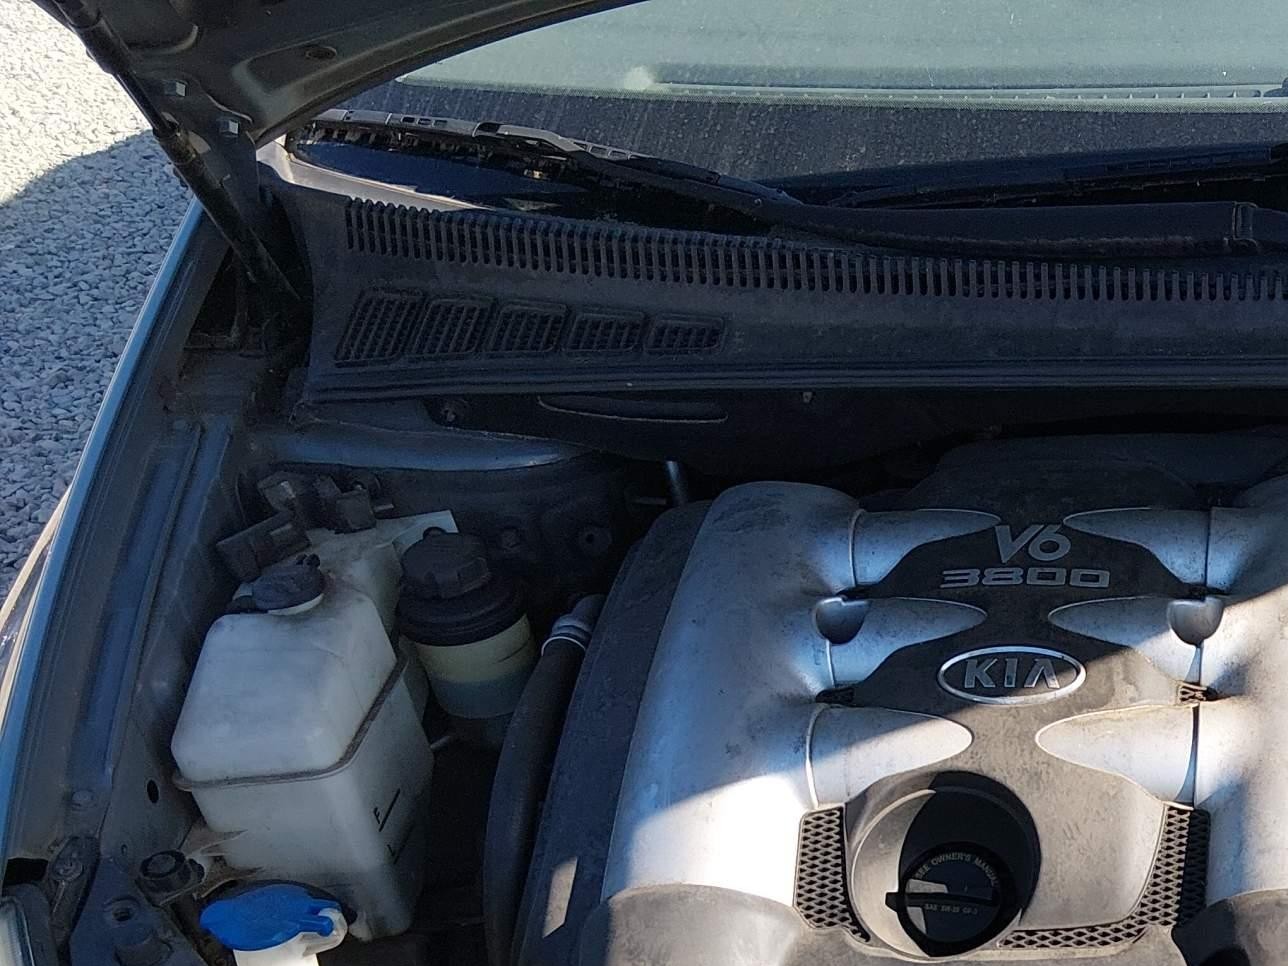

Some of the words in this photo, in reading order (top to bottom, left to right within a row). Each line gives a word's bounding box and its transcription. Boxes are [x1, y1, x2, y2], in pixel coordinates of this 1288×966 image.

[995, 524, 1071, 564] V6
[940, 567, 1110, 588] 3800
[964, 658, 1060, 688] KIA
